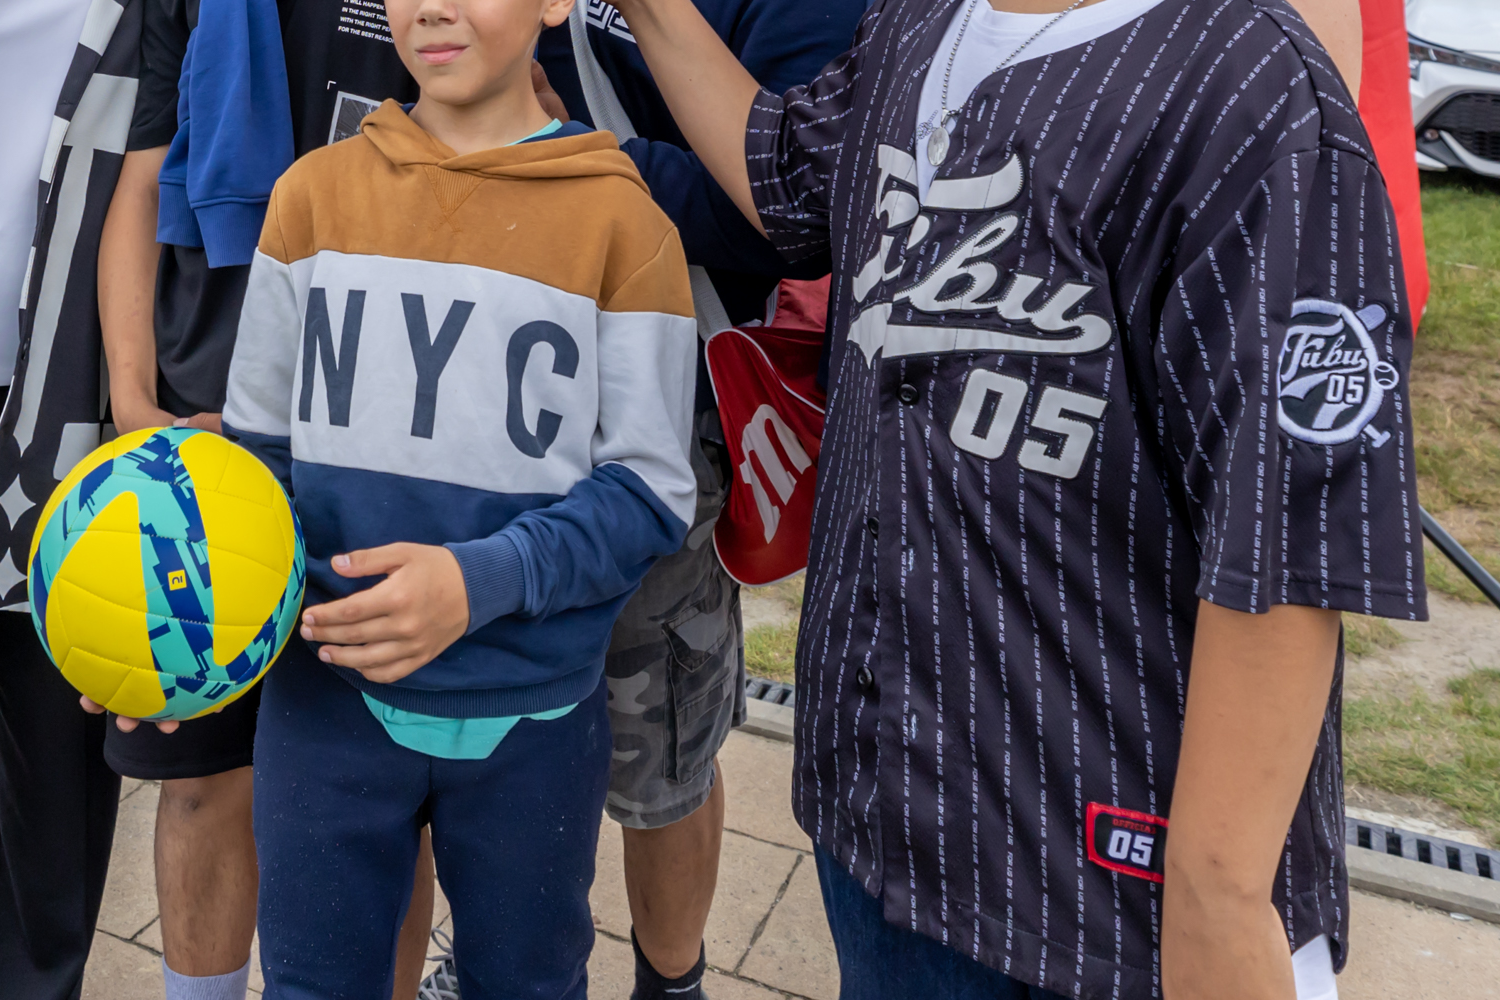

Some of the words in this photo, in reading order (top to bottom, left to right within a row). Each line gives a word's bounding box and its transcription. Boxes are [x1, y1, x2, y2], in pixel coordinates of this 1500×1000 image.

[359, 10, 375, 18] RIGHT
[340, 16, 354, 24] WITH
[354, 19, 365, 27] THE
[365, 21, 381, 29] RIGHT
[350, 28, 360, 36] THE
[361, 30, 375, 39] BEST
[1111, 56, 1121, 68] FOR
[1259, 53, 1271, 65] FOR
[1106, 67, 1114, 76] US
[1253, 63, 1262, 73] US
[1102, 76, 1109, 85] BY
[1247, 71, 1256, 81] BY
[1096, 84, 1104, 94] US
[1239, 80, 1249, 90] US
[1088, 98, 1098, 111] FOR
[1084, 111, 1092, 121] US
[1080, 121, 1088, 131] BY
[1076, 131, 1084, 141] US
[1069, 146, 1078, 159] FOR
[1065, 159, 1072, 169] US
[1061, 169, 1068, 179] BY
[1057, 178, 1064, 189] US
[1210, 177, 1221, 191] FOR
[1203, 190, 1212, 201] US
[1198, 199, 1206, 209] BY
[1189, 208, 1199, 219] US
[1234, 210, 1243, 224] FOR
[1330, 218, 1337, 229] US
[1239, 225, 1248, 235] US
[1330, 230, 1337, 240] BY
[1243, 236, 1251, 245] BY
[1246, 246, 1254, 256] US
[1330, 241, 1337, 252] US
[1206, 246, 1216, 260] FOR
[1210, 261, 1219, 271] US
[1213, 272, 1222, 281] BY
[1217, 283, 1226, 293] US
[1258, 303, 1266, 314] US
[1259, 315, 1266, 326] BY
[1260, 326, 1267, 337] US
[1261, 344, 1269, 359] FOR
[1281, 318, 1368, 384] Fubu
[1262, 360, 1269, 371] US
[299, 287, 579, 459] NYC
[1262, 372, 1268, 383] BY
[1261, 384, 1268, 395] US
[1325, 374, 1365, 404] 05
[1259, 402, 1267, 418] FOR
[950, 368, 1108, 479] 05
[1259, 418, 1266, 430] US
[1258, 430, 1266, 442] BY
[1258, 442, 1265, 454] US
[1398, 447, 1404, 458] US
[1398, 459, 1404, 470] BY
[1283, 470, 1290, 482] US
[1399, 470, 1405, 482] US
[1256, 477, 1263, 489] US
[1283, 482, 1289, 493] BY
[1361, 477, 1367, 488] US
[1256, 489, 1263, 501] BY
[1282, 494, 1288, 505] US
[1360, 489, 1367, 500] BY
[1255, 501, 1262, 513] US
[1319, 498, 1326, 509] US
[1360, 501, 1368, 513] US
[1319, 509, 1326, 520] BY
[1402, 506, 1408, 518] US
[1254, 520, 1262, 535] FOR
[1319, 520, 1326, 532] US
[1361, 519, 1369, 536] FOR
[1403, 519, 1410, 530] BY
[1281, 528, 1287, 538] US
[1404, 531, 1411, 543] US
[1254, 536, 1260, 548] US
[1281, 539, 1287, 550] BY
[1319, 539, 1327, 555] FOR
[1362, 536, 1369, 548] US
[1253, 548, 1260, 560] BY
[1281, 551, 1287, 562] US
[1363, 549, 1370, 560] BY
[1252, 560, 1259, 571] US
[1320, 556, 1327, 568] US
[1363, 561, 1370, 573] US
[1320, 568, 1328, 579] BY
[1406, 568, 1412, 579] US
[1321, 580, 1328, 591] US
[1405, 580, 1412, 591] BY
[932, 594, 938, 604] US
[1406, 592, 1413, 604] US
[932, 604, 938, 614] BY
[932, 614, 938, 625] US
[997, 610, 1004, 621] US
[998, 621, 1004, 632] BY
[998, 632, 1005, 643] US
[1036, 703, 1042, 714] US
[1036, 714, 1042, 725] BY
[1036, 726, 1042, 736] US
[1072, 733, 1079, 744] US
[1073, 744, 1080, 755] BY
[1073, 756, 1080, 767] US
[1108, 830, 1154, 867] 05
[1077, 890, 1084, 902] US
[1077, 902, 1084, 913] BY
[1077, 913, 1084, 923] US
